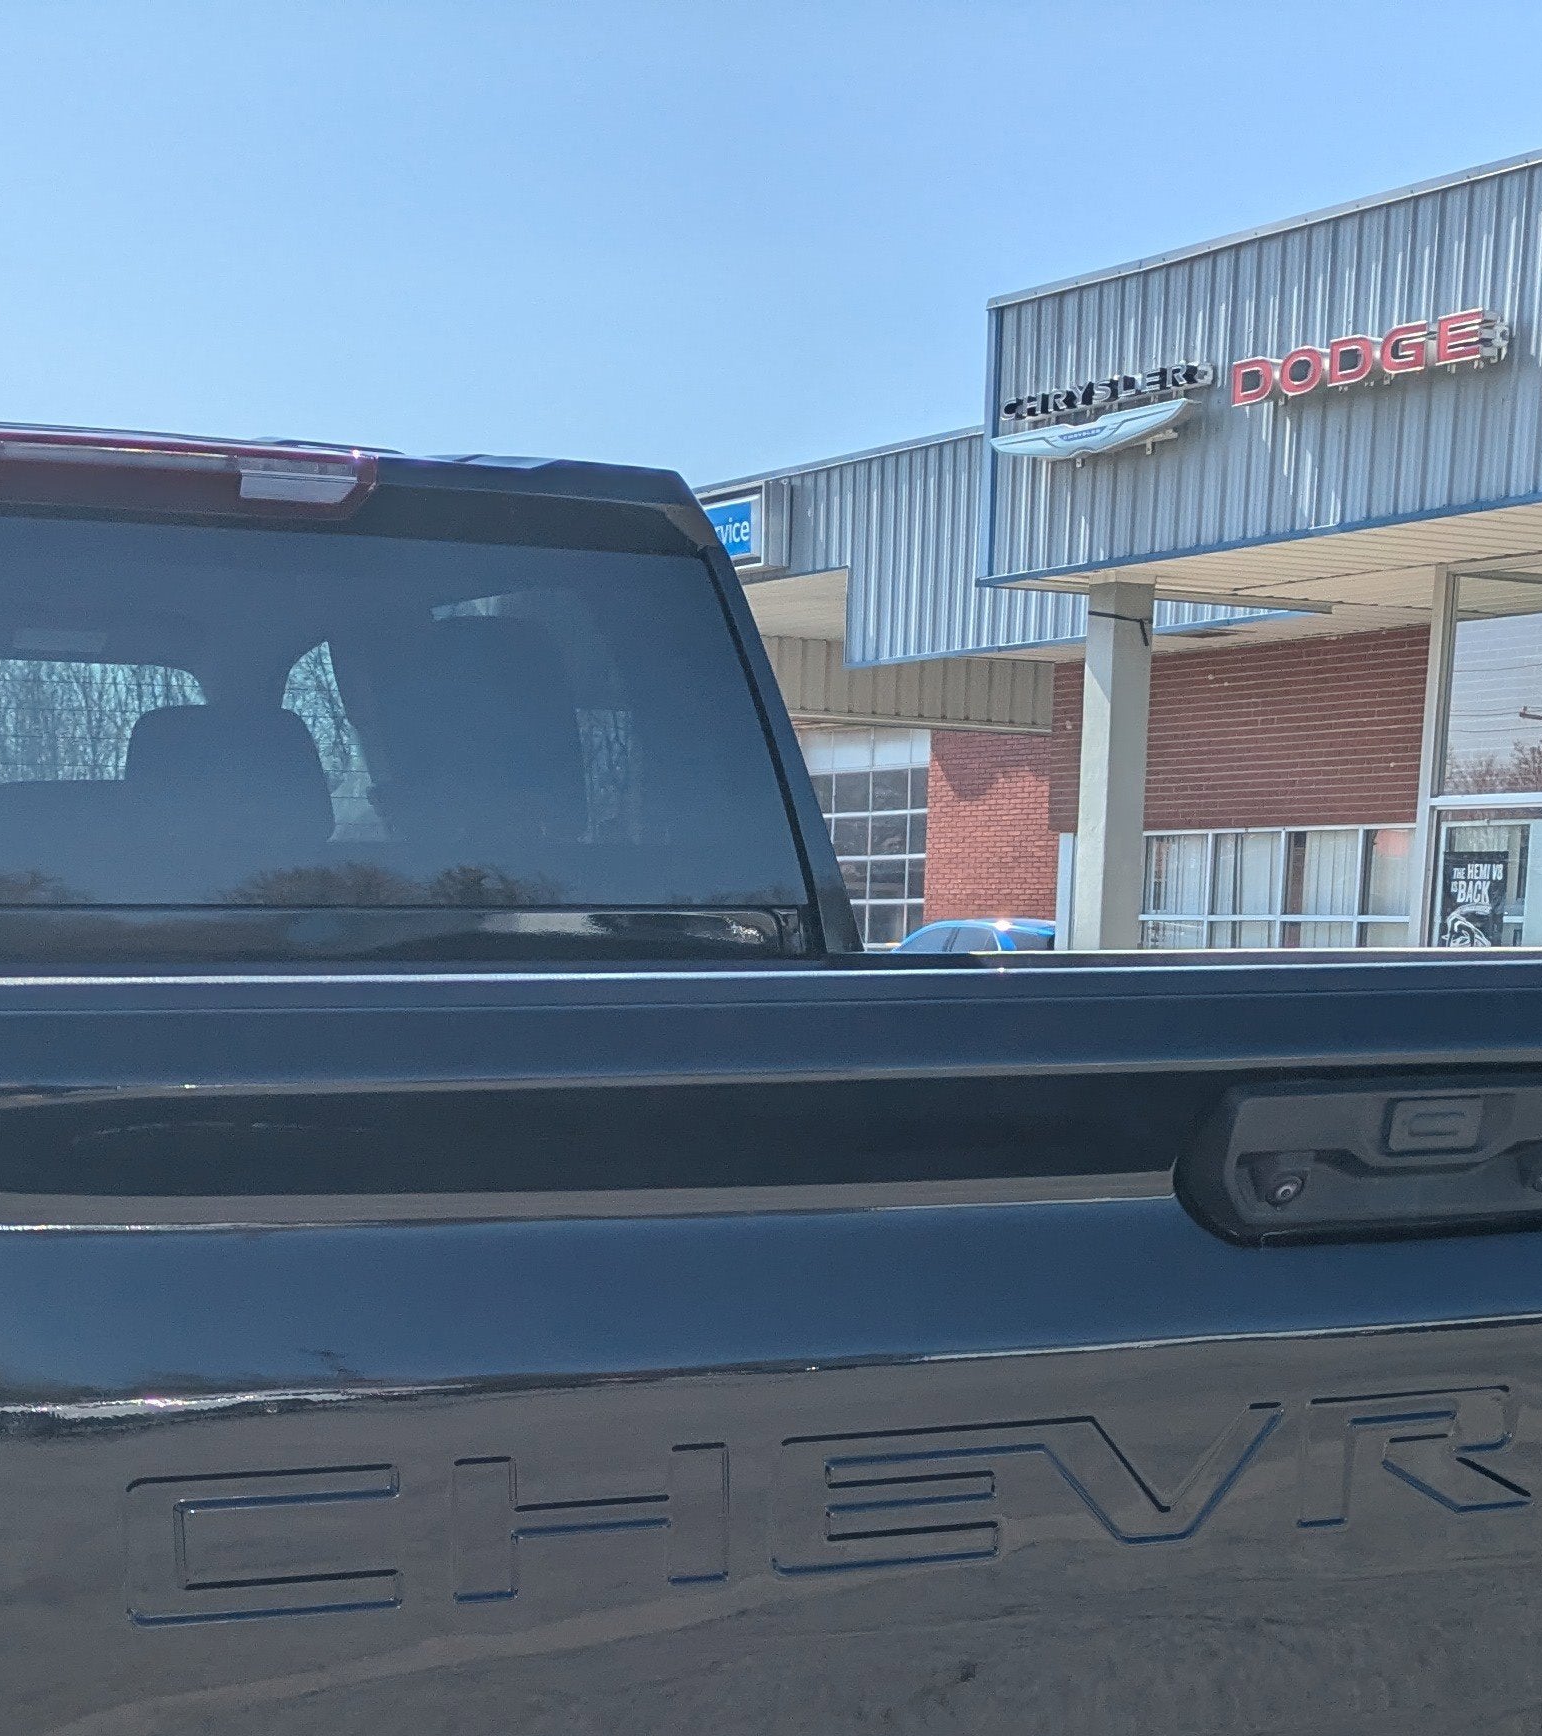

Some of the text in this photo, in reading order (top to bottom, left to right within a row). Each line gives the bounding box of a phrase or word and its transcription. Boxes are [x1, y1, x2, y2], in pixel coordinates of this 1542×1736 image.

[1231, 307, 1484, 407] DODGE
[1000, 363, 1194, 421] CHRYSLER
[1452, 863, 1504, 880] THE HEMI V8
[1451, 881, 1490, 904] IS BACK
